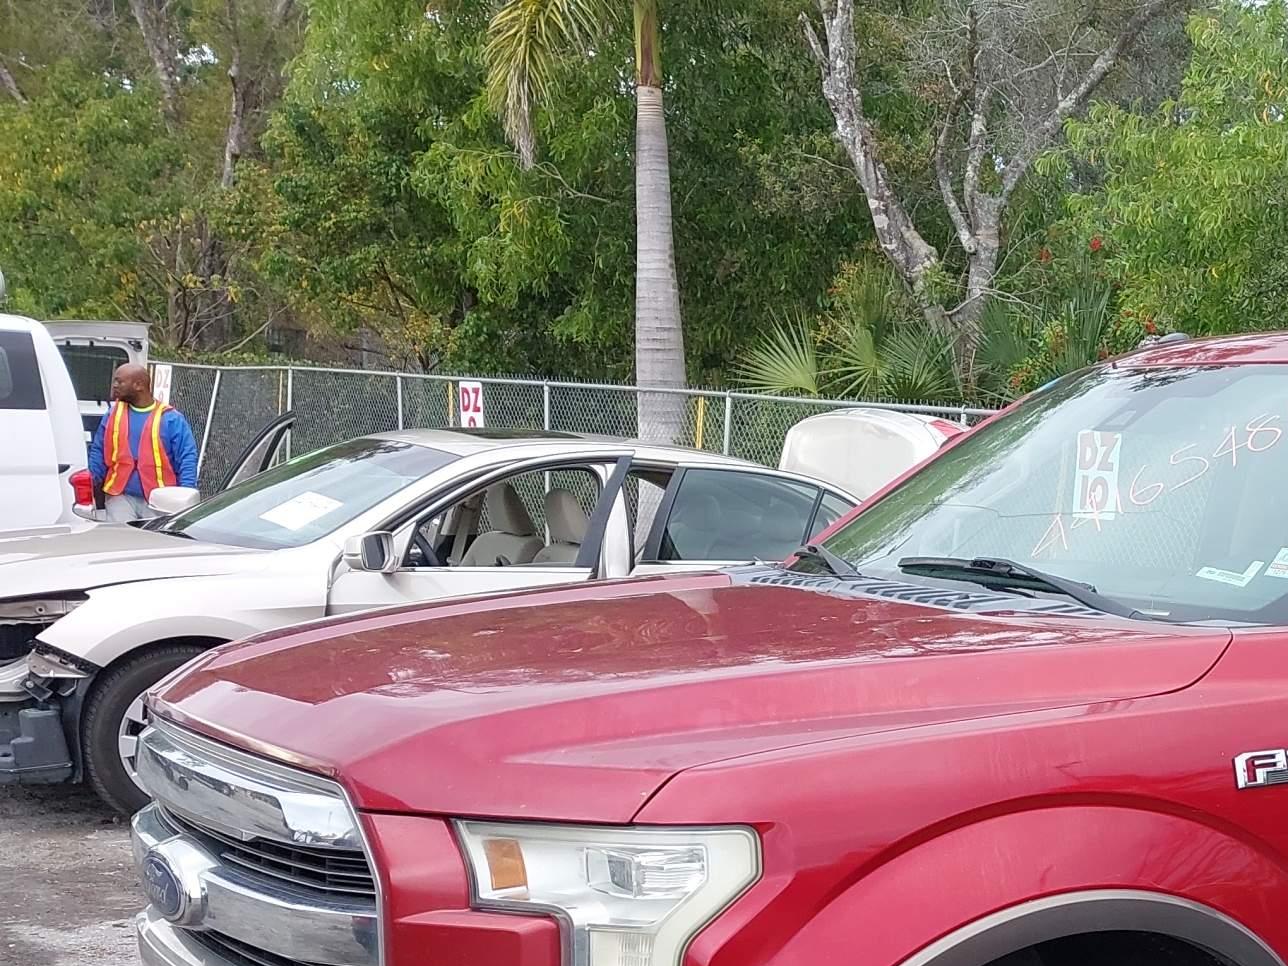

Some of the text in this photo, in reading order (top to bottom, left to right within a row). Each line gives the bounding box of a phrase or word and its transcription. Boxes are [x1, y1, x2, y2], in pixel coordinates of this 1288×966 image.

[156, 368, 170, 388] DZ
[461, 387, 481, 412] DZ
[1078, 432, 1120, 471] DZ
[1081, 475, 1110, 512] 10
